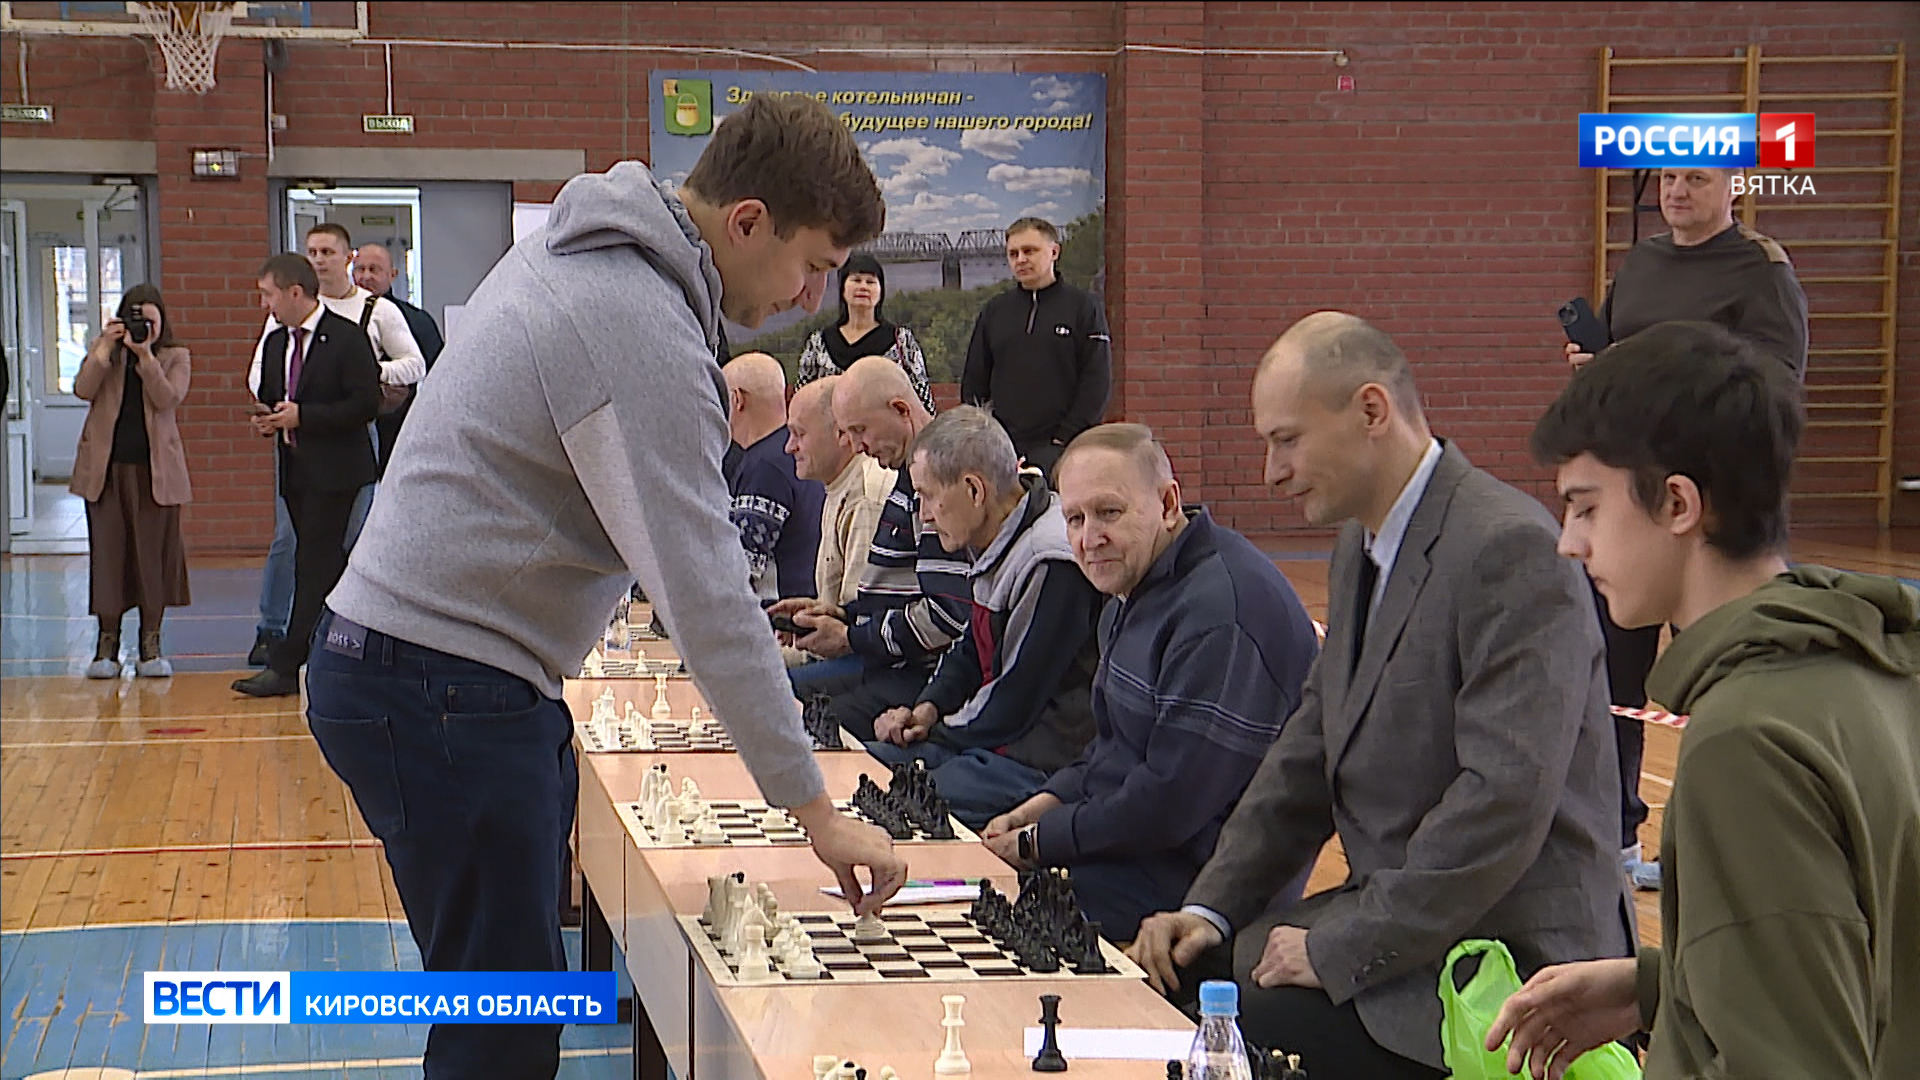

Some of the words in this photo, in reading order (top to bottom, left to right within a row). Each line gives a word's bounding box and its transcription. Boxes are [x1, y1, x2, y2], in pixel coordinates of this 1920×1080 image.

[832, 91, 962, 105] котельничан
[839, 111, 929, 132] будущее
[934, 115, 1010, 130] нашего
[1014, 112, 1093, 132] города!
